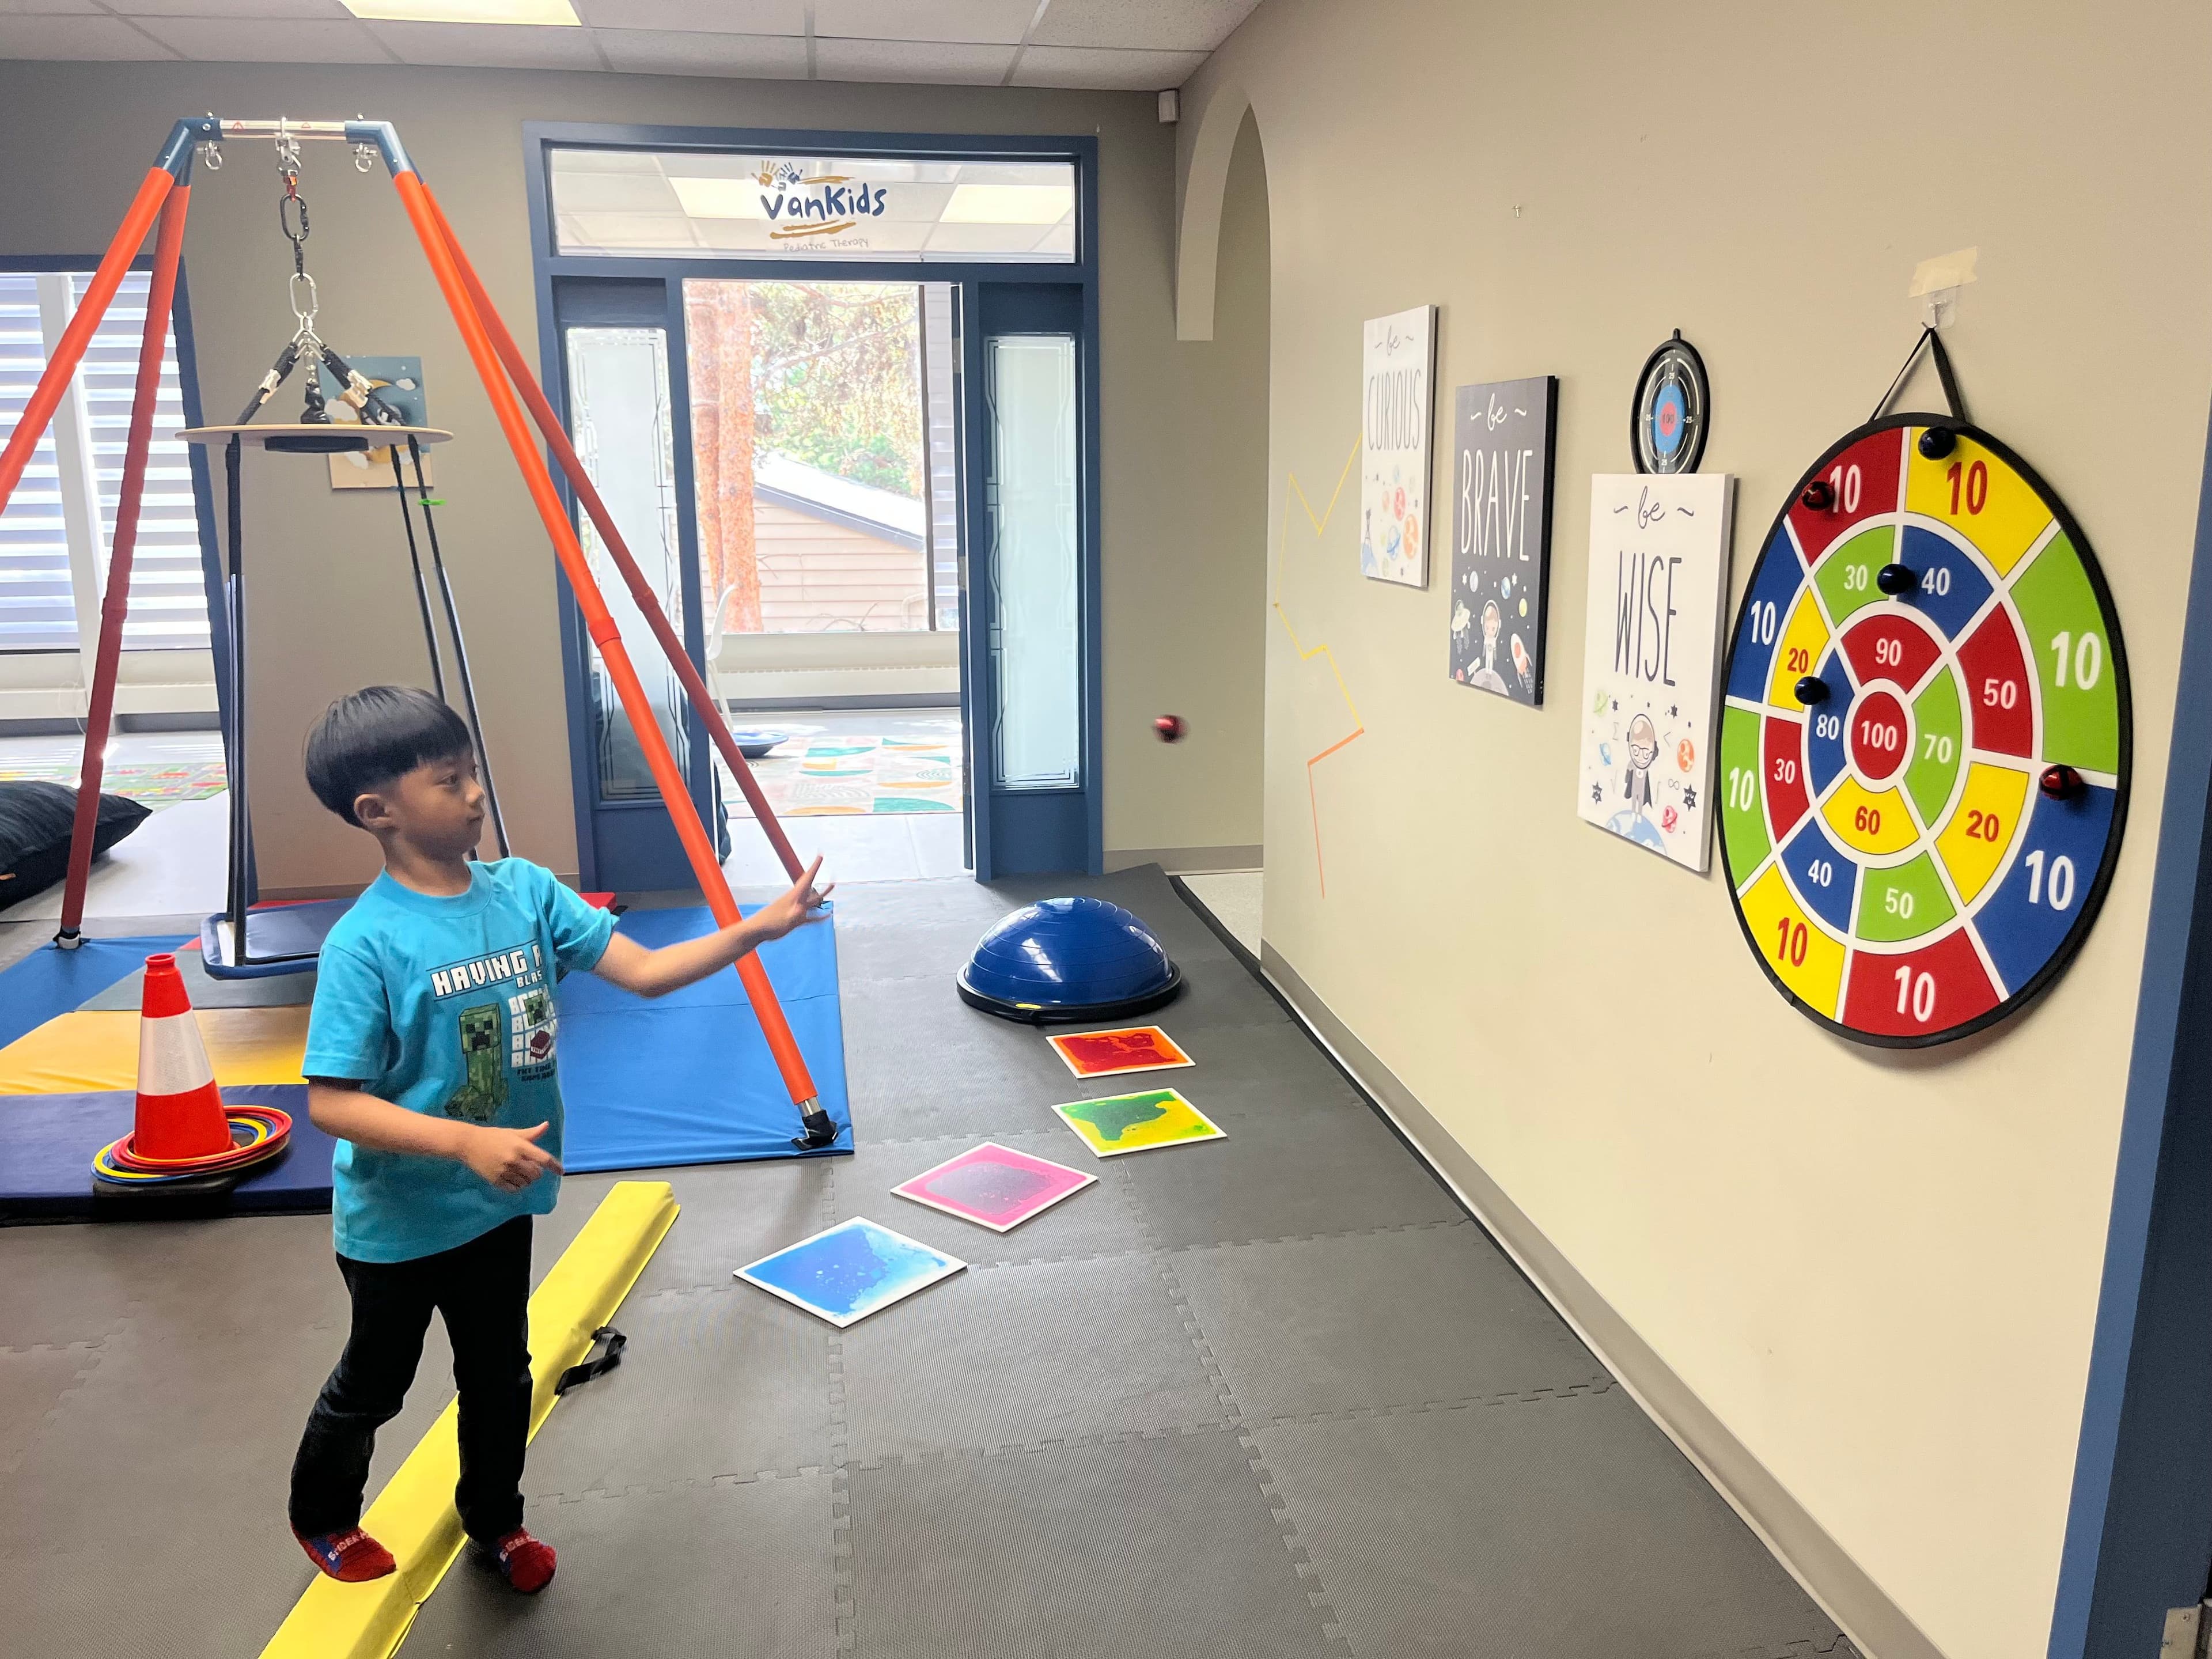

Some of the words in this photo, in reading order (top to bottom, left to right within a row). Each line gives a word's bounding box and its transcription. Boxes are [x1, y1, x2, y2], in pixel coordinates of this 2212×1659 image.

[760, 182, 887, 221] VanKids
[830, 238, 869, 248] Therapy
[1387, 324, 1400, 356] be
[1368, 368, 1421, 450] CURIOUS
[1487, 393, 1507, 431] be
[1461, 449, 1532, 561] BRAVE
[1830, 464, 1861, 513] 10
[1946, 460, 1987, 516] 10
[1638, 486, 1665, 529] be
[1843, 565, 1868, 591] 30
[1921, 567, 1950, 596] 40
[1615, 550, 1682, 687] WISE
[1751, 601, 1775, 646] 10
[1787, 648, 1809, 673] 20
[1876, 638, 1901, 666] 90
[2051, 631, 2101, 691] 10
[1983, 679, 2017, 710] 50
[1816, 714, 1839, 740] 80
[1861, 720, 1897, 752] 100
[1924, 733, 1952, 764] 70
[1728, 767, 1755, 812] 10
[1774, 759, 1796, 784] 30
[1854, 805, 1880, 835] 60
[1965, 809, 1999, 843] 20
[1808, 859, 1832, 887] 40
[2025, 850, 2074, 911] 10
[1885, 888, 1914, 919] 50
[1778, 917, 1808, 967] 10
[431, 949, 528, 997] HAVING
[1894, 965, 1936, 1022] 10
